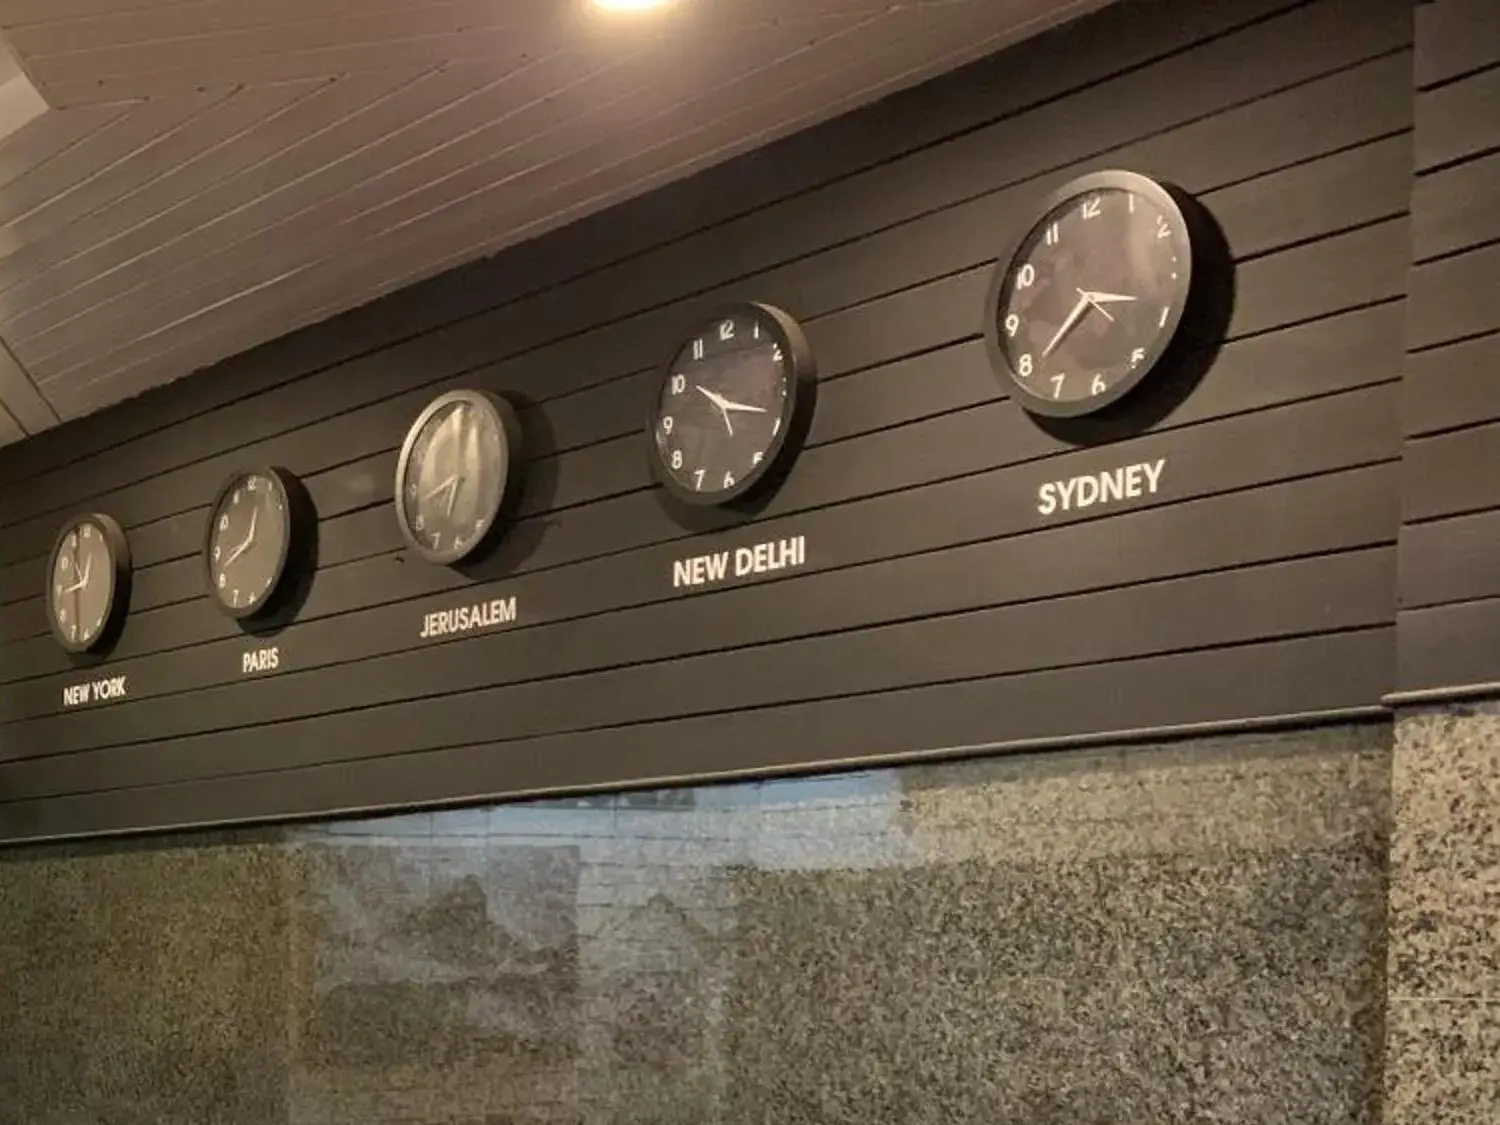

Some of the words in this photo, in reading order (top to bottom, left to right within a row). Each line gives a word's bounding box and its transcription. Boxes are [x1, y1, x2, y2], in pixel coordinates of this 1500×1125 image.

[1081, 197, 1101, 220] 12
[1016, 263, 1035, 289] 10
[1005, 314, 1019, 336] 9
[1018, 354, 1033, 376] 8
[671, 374, 686, 395] 10
[1051, 373, 1065, 399] 7
[1091, 373, 1107, 396] 6
[663, 416, 673, 435] 9
[671, 450, 683, 470] 8
[694, 469, 706, 491] 7
[1037, 459, 1166, 515] SYDNEY
[673, 549, 729, 587] NEW
[735, 535, 805, 575] DELHI
[419, 597, 517, 639] JERUSALEM
[242, 647, 279, 673] PARIS
[63, 682, 91, 706] NEW
[91, 675, 127, 700] YORK
